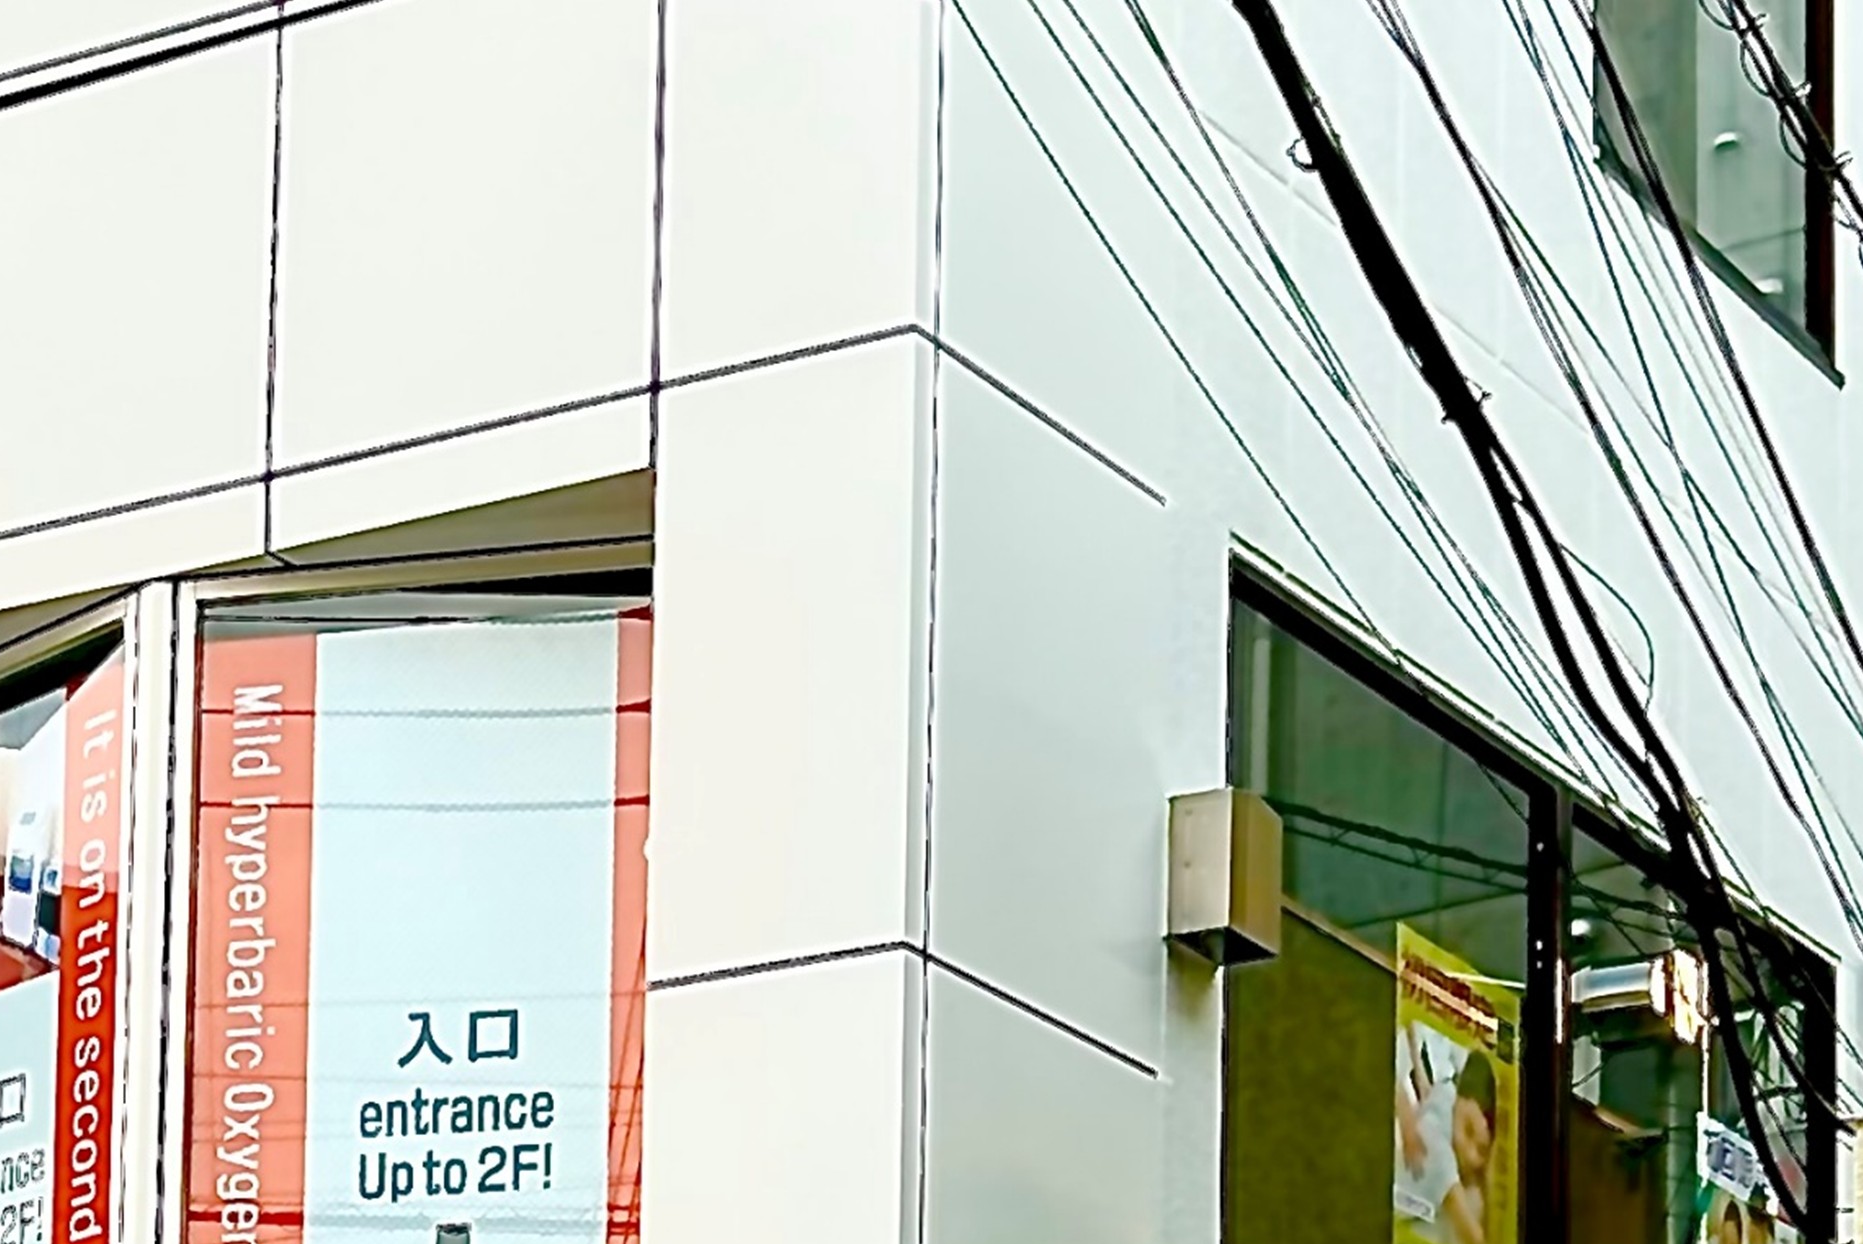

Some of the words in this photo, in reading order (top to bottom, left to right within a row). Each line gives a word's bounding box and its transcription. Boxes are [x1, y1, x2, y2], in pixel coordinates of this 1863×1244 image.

[82, 708, 117, 758] It
[230, 684, 284, 778] Mild
[79, 772, 117, 823] is
[78, 838, 107, 909] on
[222, 794, 283, 1071] hyperbaric
[74, 920, 112, 1021] the
[397, 1008, 520, 1067] 入口
[68, 1037, 104, 1244] second
[359, 1087, 555, 1138] entrance
[358, 1151, 415, 1203] Up
[422, 1149, 468, 1196] to
[477, 1142, 554, 1192] 2F!
